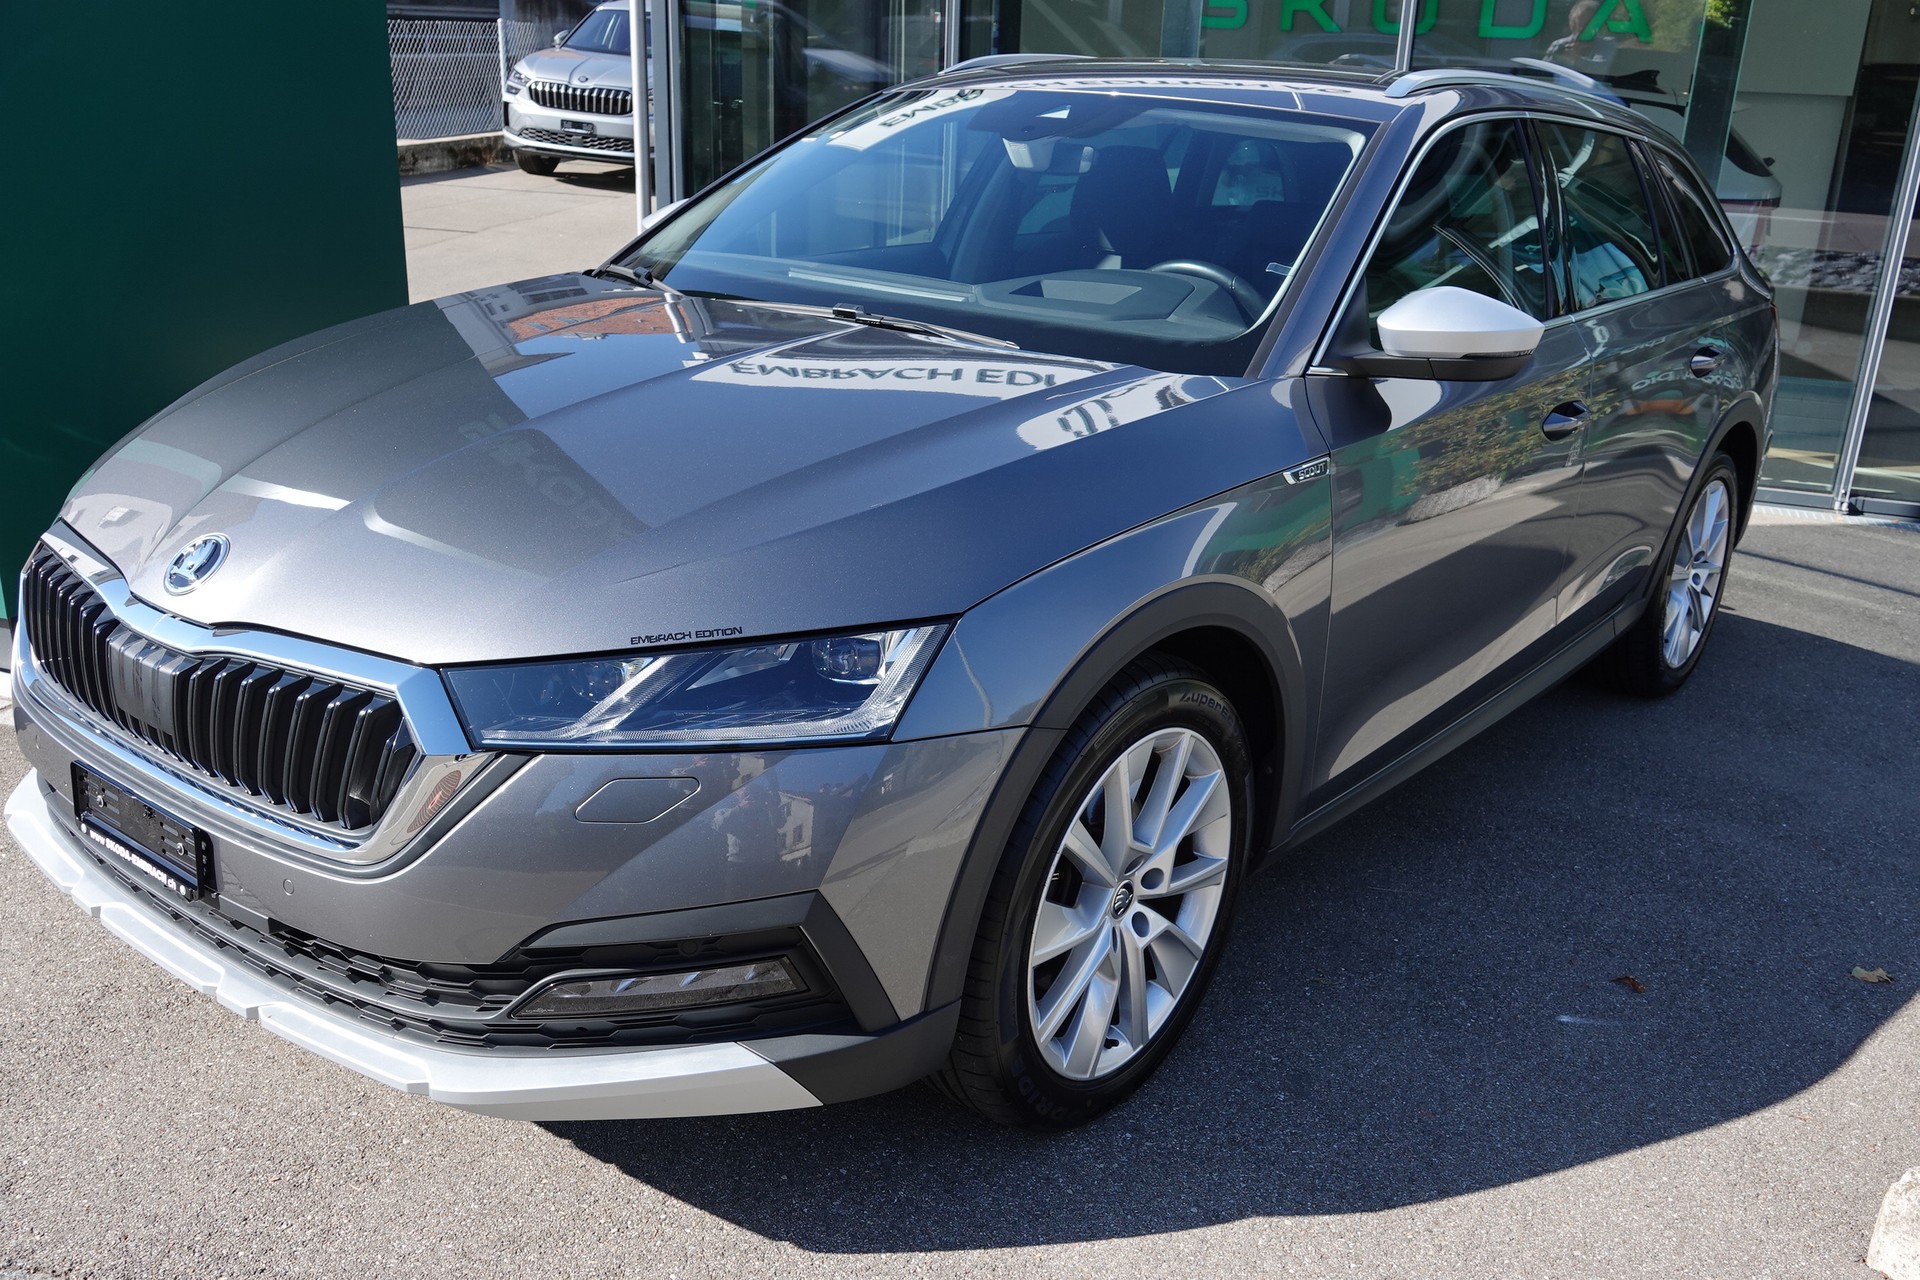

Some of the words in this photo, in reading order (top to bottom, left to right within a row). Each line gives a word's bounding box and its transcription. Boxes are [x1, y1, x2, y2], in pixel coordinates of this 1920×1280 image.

[1298, 462, 1326, 481] SCOUT
[630, 631, 692, 646] EMBRACH
[695, 626, 743, 639] EDITION
